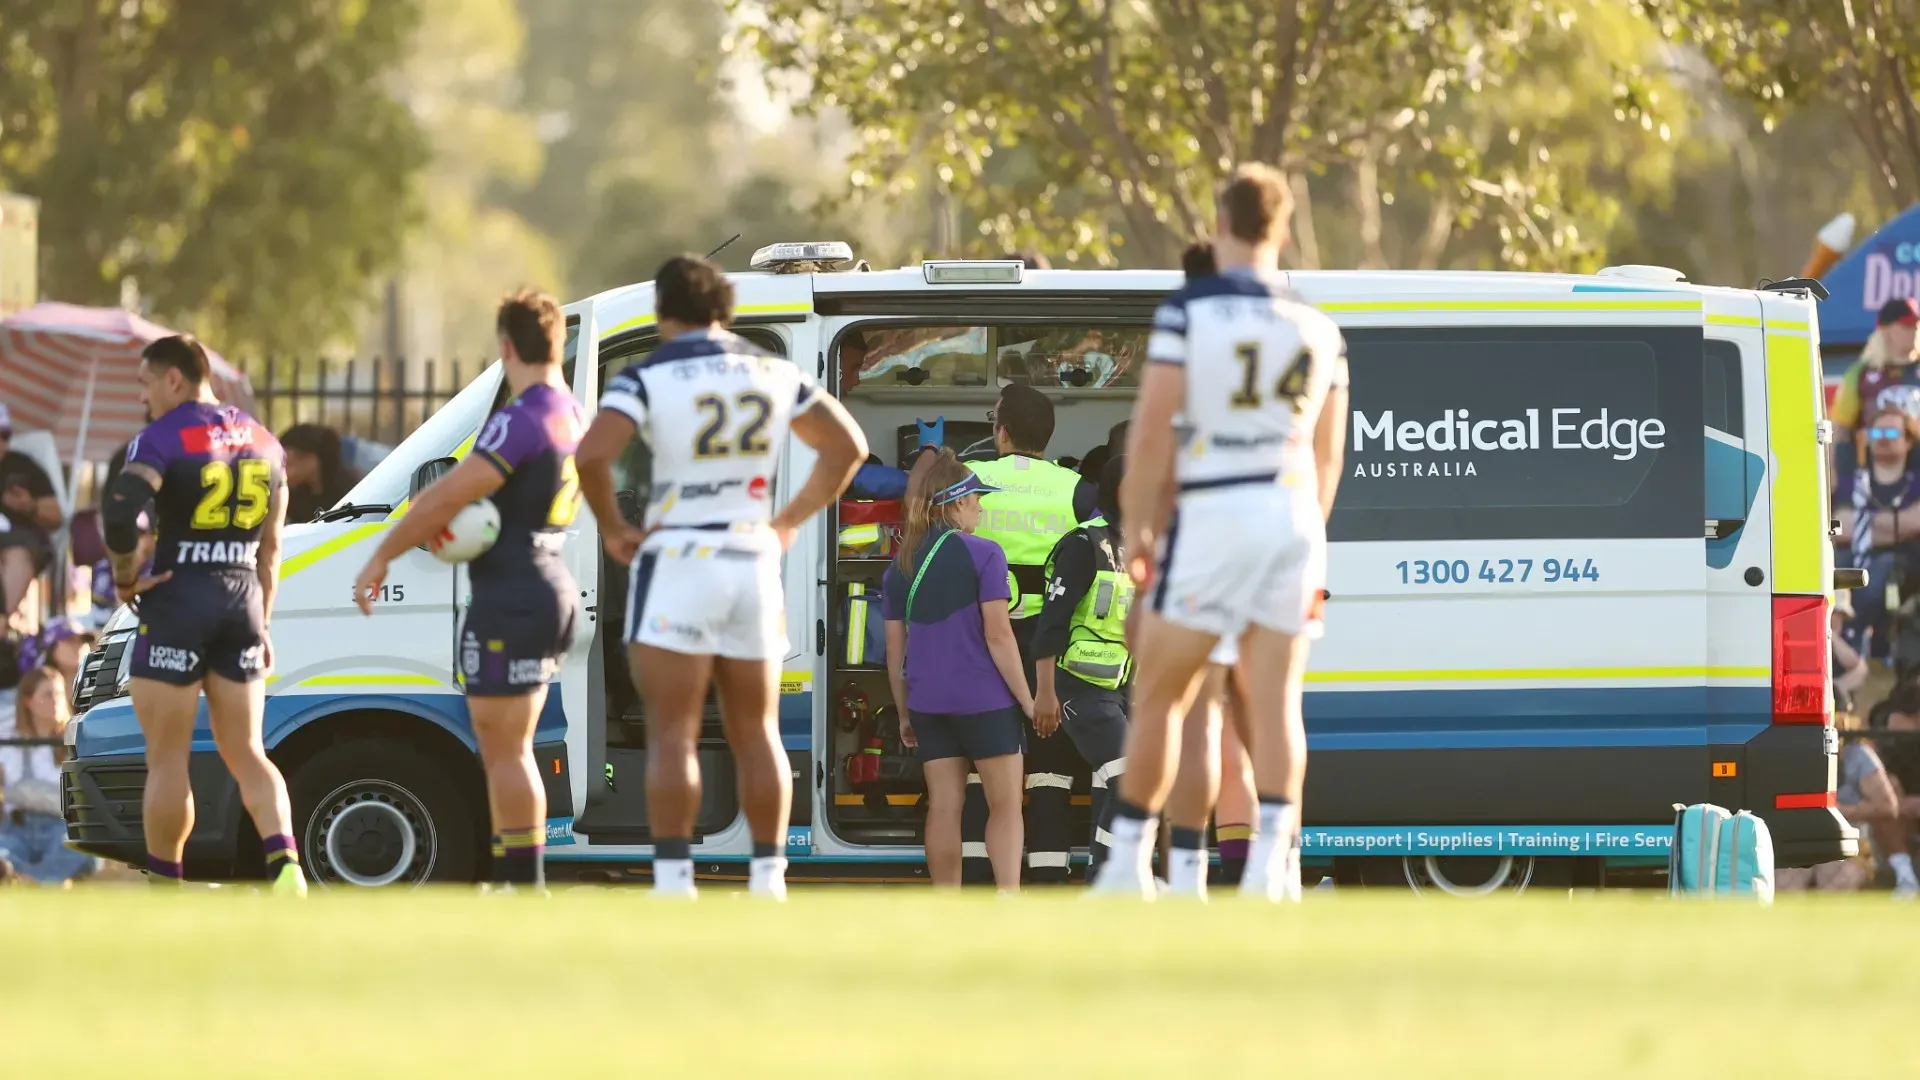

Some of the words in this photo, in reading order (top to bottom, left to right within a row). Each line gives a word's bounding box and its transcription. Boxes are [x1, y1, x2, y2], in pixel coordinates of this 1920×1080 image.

[1230, 342, 1314, 414] 14
[694, 390, 771, 460] 22
[1353, 408, 1540, 452] Medical
[1552, 407, 1666, 461] Edge
[1354, 461, 1478, 478] AUSTRALIA
[191, 459, 271, 529] 25
[1396, 560, 1469, 584] 1300
[1478, 559, 1533, 583] 427
[1542, 558, 1599, 582] 944
[149, 645, 188, 659] LOTUS
[1080, 649, 1103, 658] Medical
[149, 656, 187, 672] LIVING
[547, 825, 566, 839] Event
[1316, 832, 1402, 851] Transport
[1417, 832, 1493, 851] Supplies
[1508, 832, 1580, 851] Training
[1596, 832, 1629, 847] Fire
[1634, 832, 1673, 847] Serv
